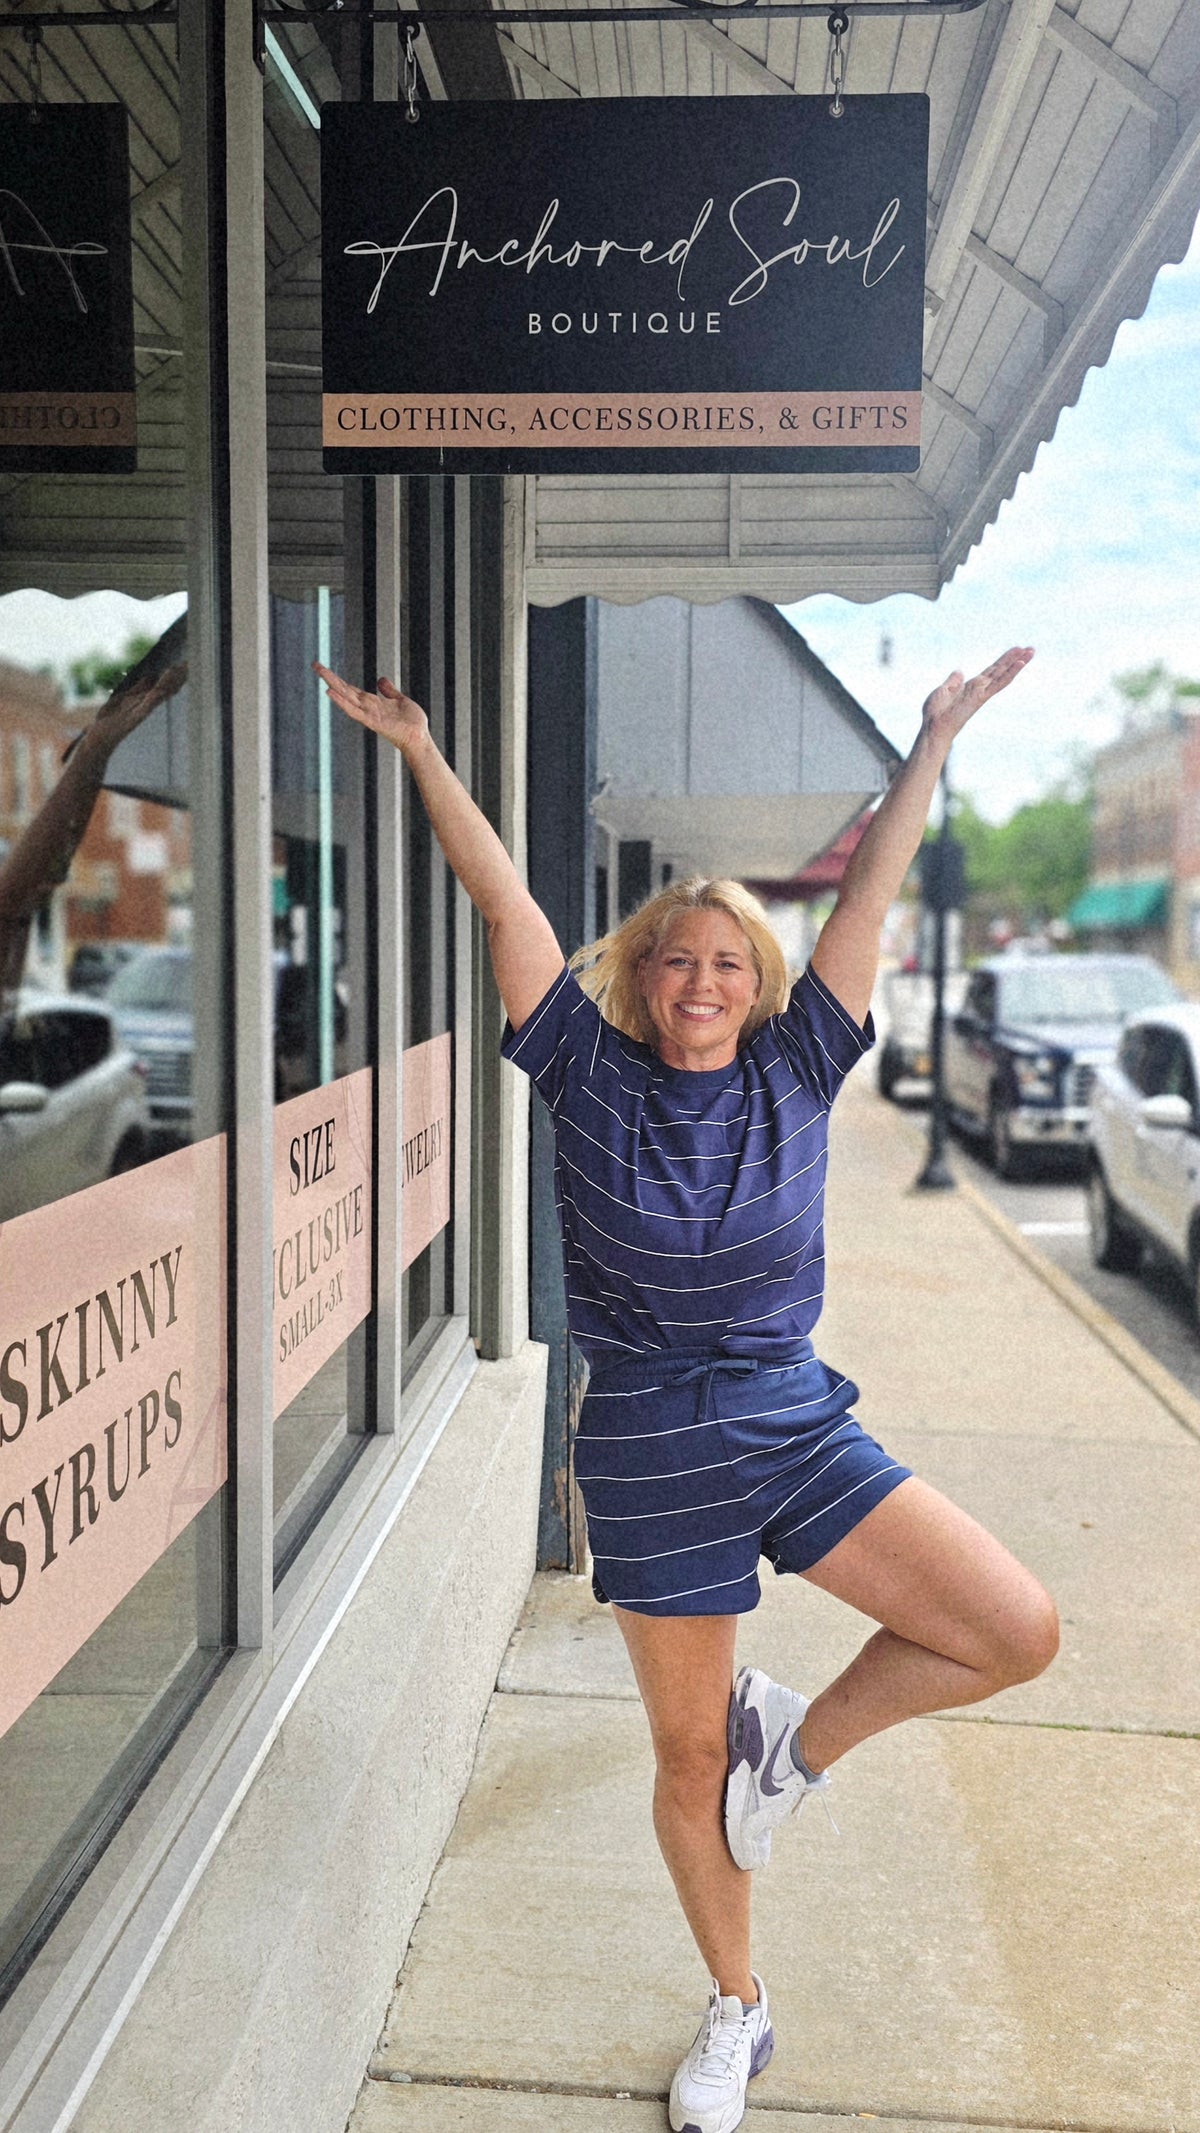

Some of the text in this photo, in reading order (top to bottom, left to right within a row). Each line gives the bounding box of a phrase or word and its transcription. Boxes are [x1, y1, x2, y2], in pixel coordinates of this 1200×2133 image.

[343, 177, 905, 314] Anchored Soul
[528, 311, 721, 335] BOUTIQUE
[337, 405, 908, 434] CLOTHING, ACCESSORIES, & GIFTS
[289, 1118, 336, 1196] SIZE
[402, 1118, 443, 1188] WELRY
[273, 1184, 363, 1310] CLUSIVE
[0, 1245, 182, 1447] SKINNY
[0, 1368, 182, 1605] SYRUPS
